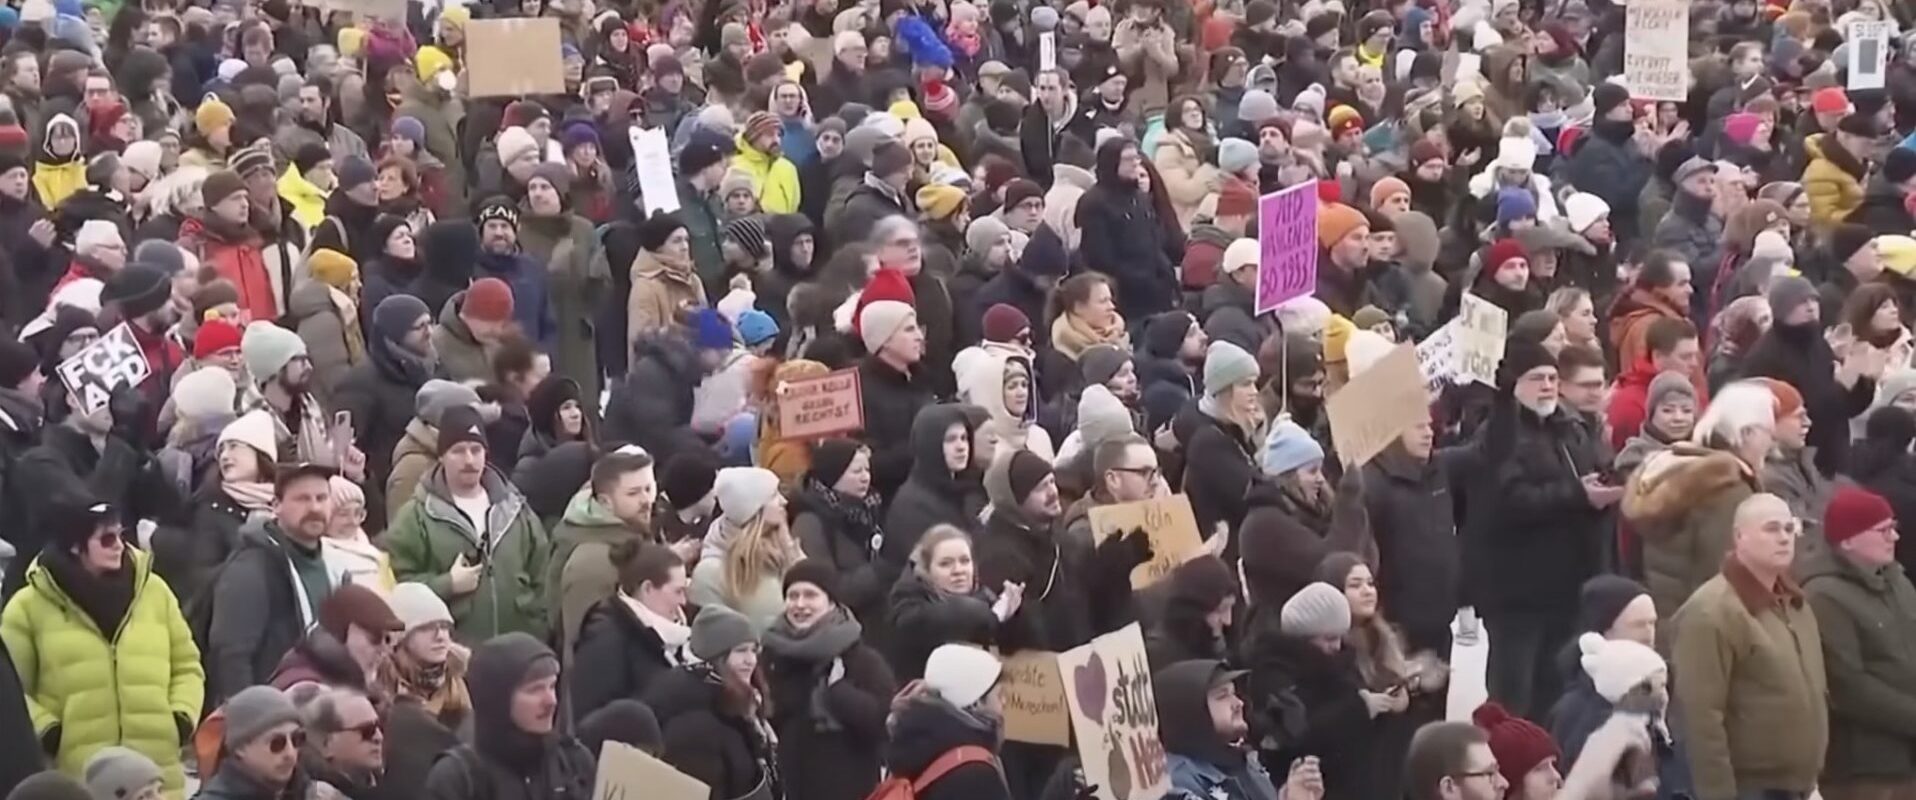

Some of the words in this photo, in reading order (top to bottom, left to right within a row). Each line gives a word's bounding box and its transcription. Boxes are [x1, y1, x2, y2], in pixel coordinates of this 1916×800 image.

[480, 205, 517, 225] YEAH
[61, 324, 137, 392] FCK
[84, 353, 147, 413] AFD
